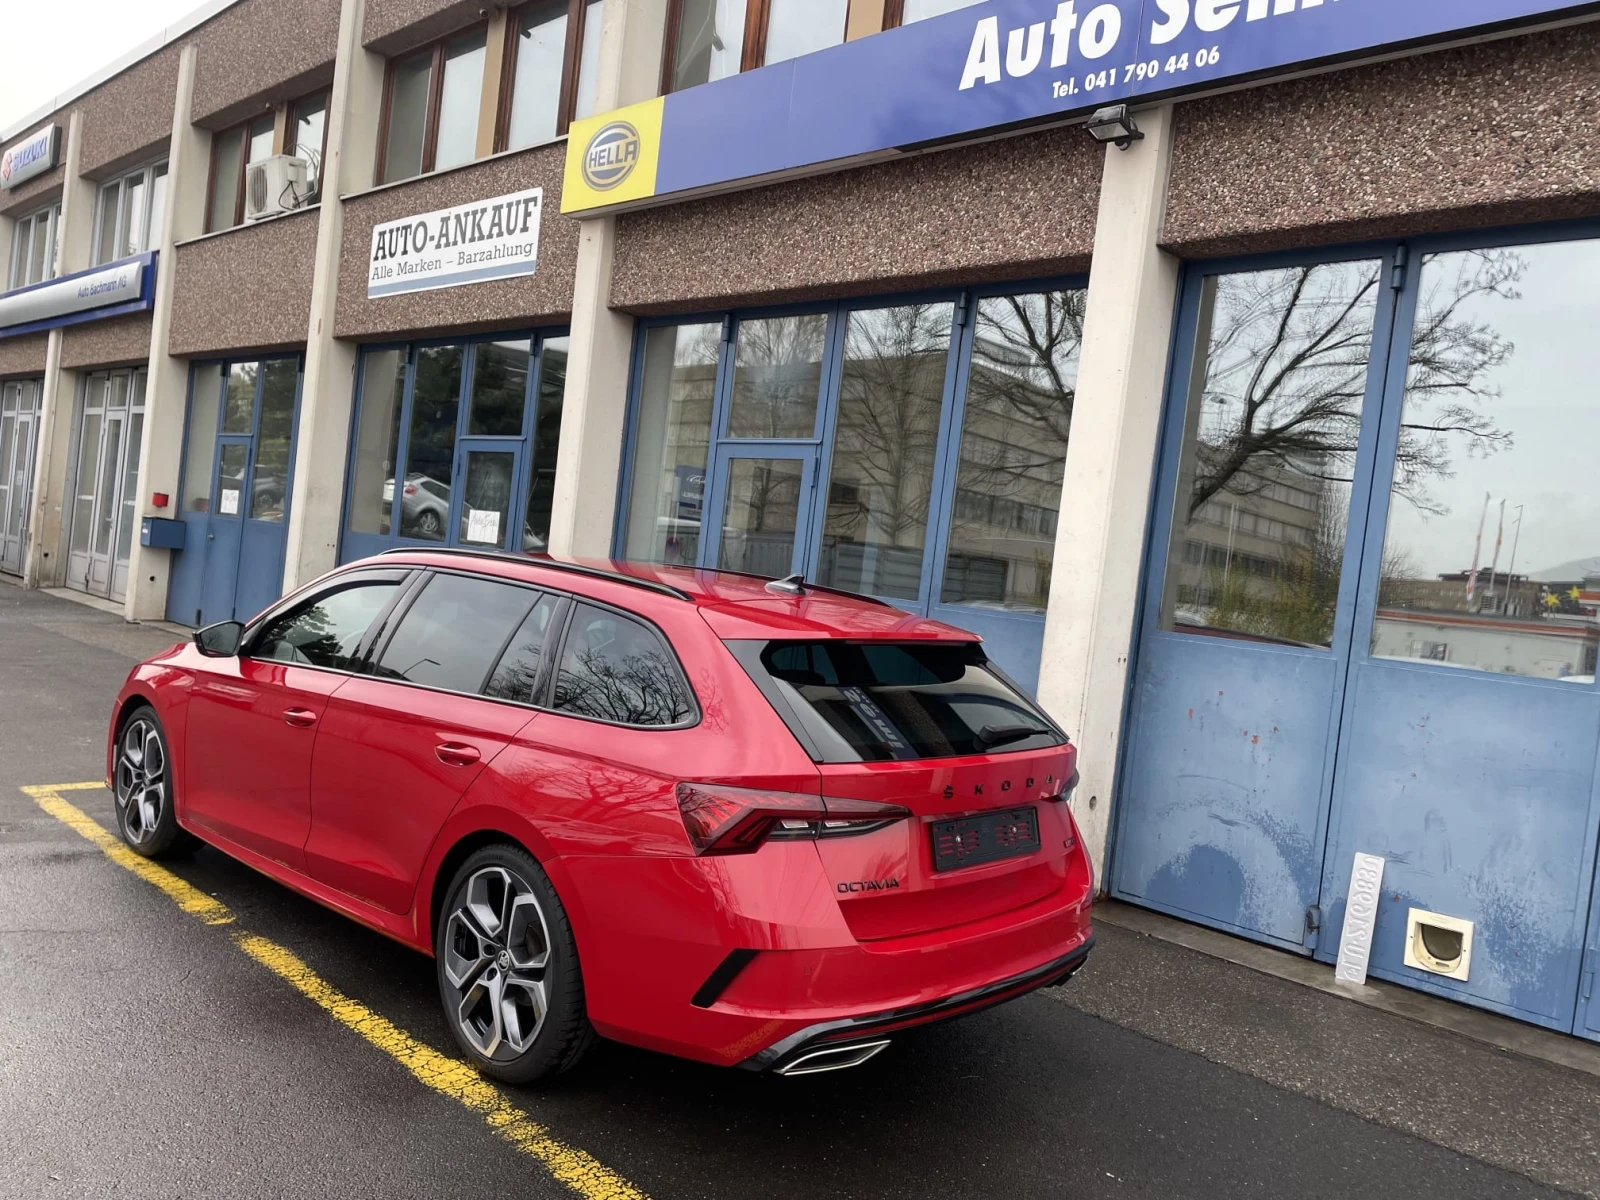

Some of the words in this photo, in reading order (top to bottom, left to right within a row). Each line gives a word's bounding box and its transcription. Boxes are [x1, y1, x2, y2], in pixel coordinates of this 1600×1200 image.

[958, 0, 1122, 90] Auto
[1053, 77, 1079, 98] Tel.
[1084, 68, 1117, 92] 041
[1123, 60, 1159, 83] 790
[1164, 53, 1189, 73] 44
[1195, 46, 1220, 67] 06
[12, 136, 48, 171] SUZUKI
[589, 140, 638, 169] HELLA
[373, 196, 538, 262] AUTO-ANKAUF
[371, 267, 393, 281] Alle
[397, 259, 442, 276] Marken
[457, 242, 534, 266] Barzahlung
[77, 285, 90, 299] Auto
[118, 274, 127, 289] AG
[837, 878, 900, 893] OCTAVIA
